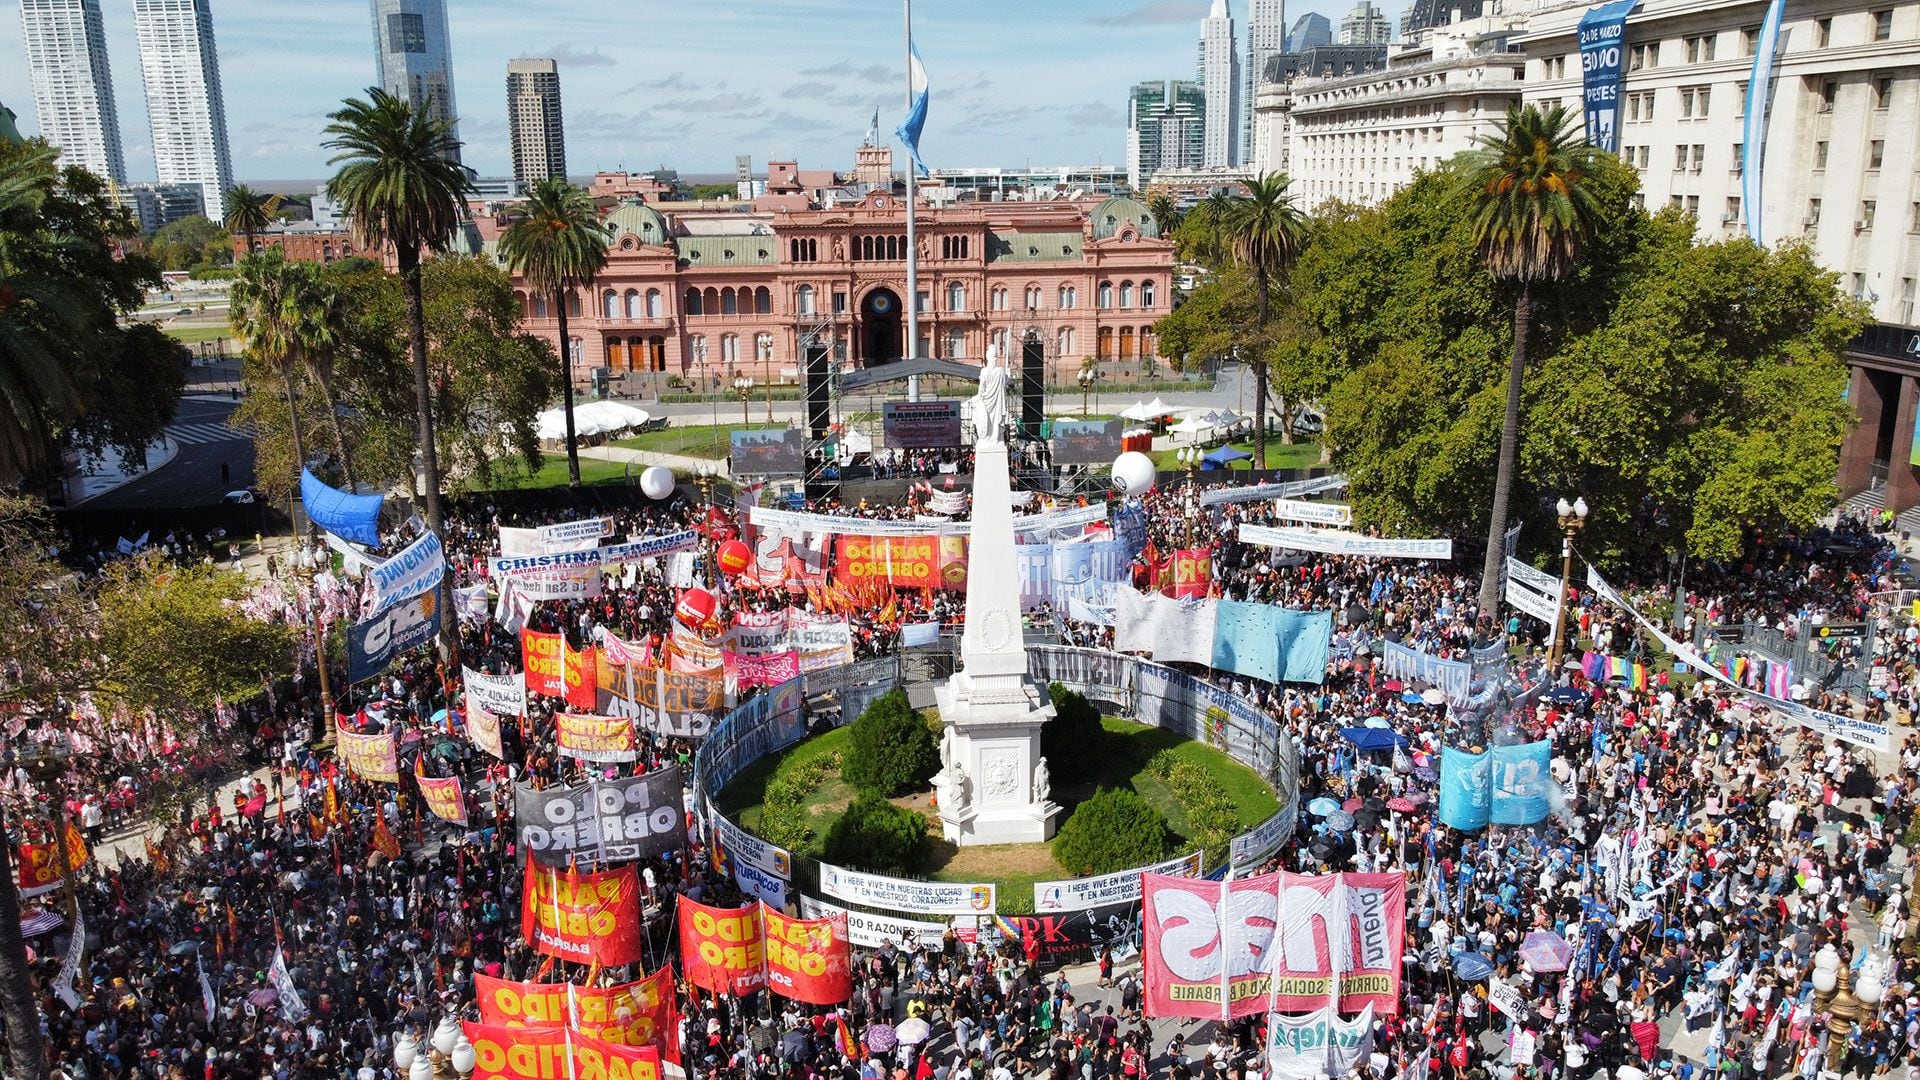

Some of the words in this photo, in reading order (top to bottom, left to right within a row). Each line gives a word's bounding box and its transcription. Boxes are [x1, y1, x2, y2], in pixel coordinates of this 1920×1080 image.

[1581, 30, 1591, 43] 24
[1590, 28, 1599, 41] DE
[1600, 24, 1622, 39] MARZO
[607, 530, 696, 555] FERNANDO
[497, 550, 601, 572] CRISTINA
[1812, 711, 1847, 726] GASTON
[868, 879, 884, 889] VIVE
[886, 882, 896, 892] EN
[897, 884, 933, 896] NUESTRAS
[935, 887, 963, 897] LUCHAS
[1092, 878, 1108, 889] VIVE
[1109, 876, 1119, 887] EN
[861, 888, 870, 897] EN
[873, 889, 909, 902] NUESTROS
[1087, 889, 1098, 900] EN
[1099, 883, 1135, 898] NUESTROS
[867, 921, 916, 937] RAZONES
[1493, 989, 1509, 1005] DE
